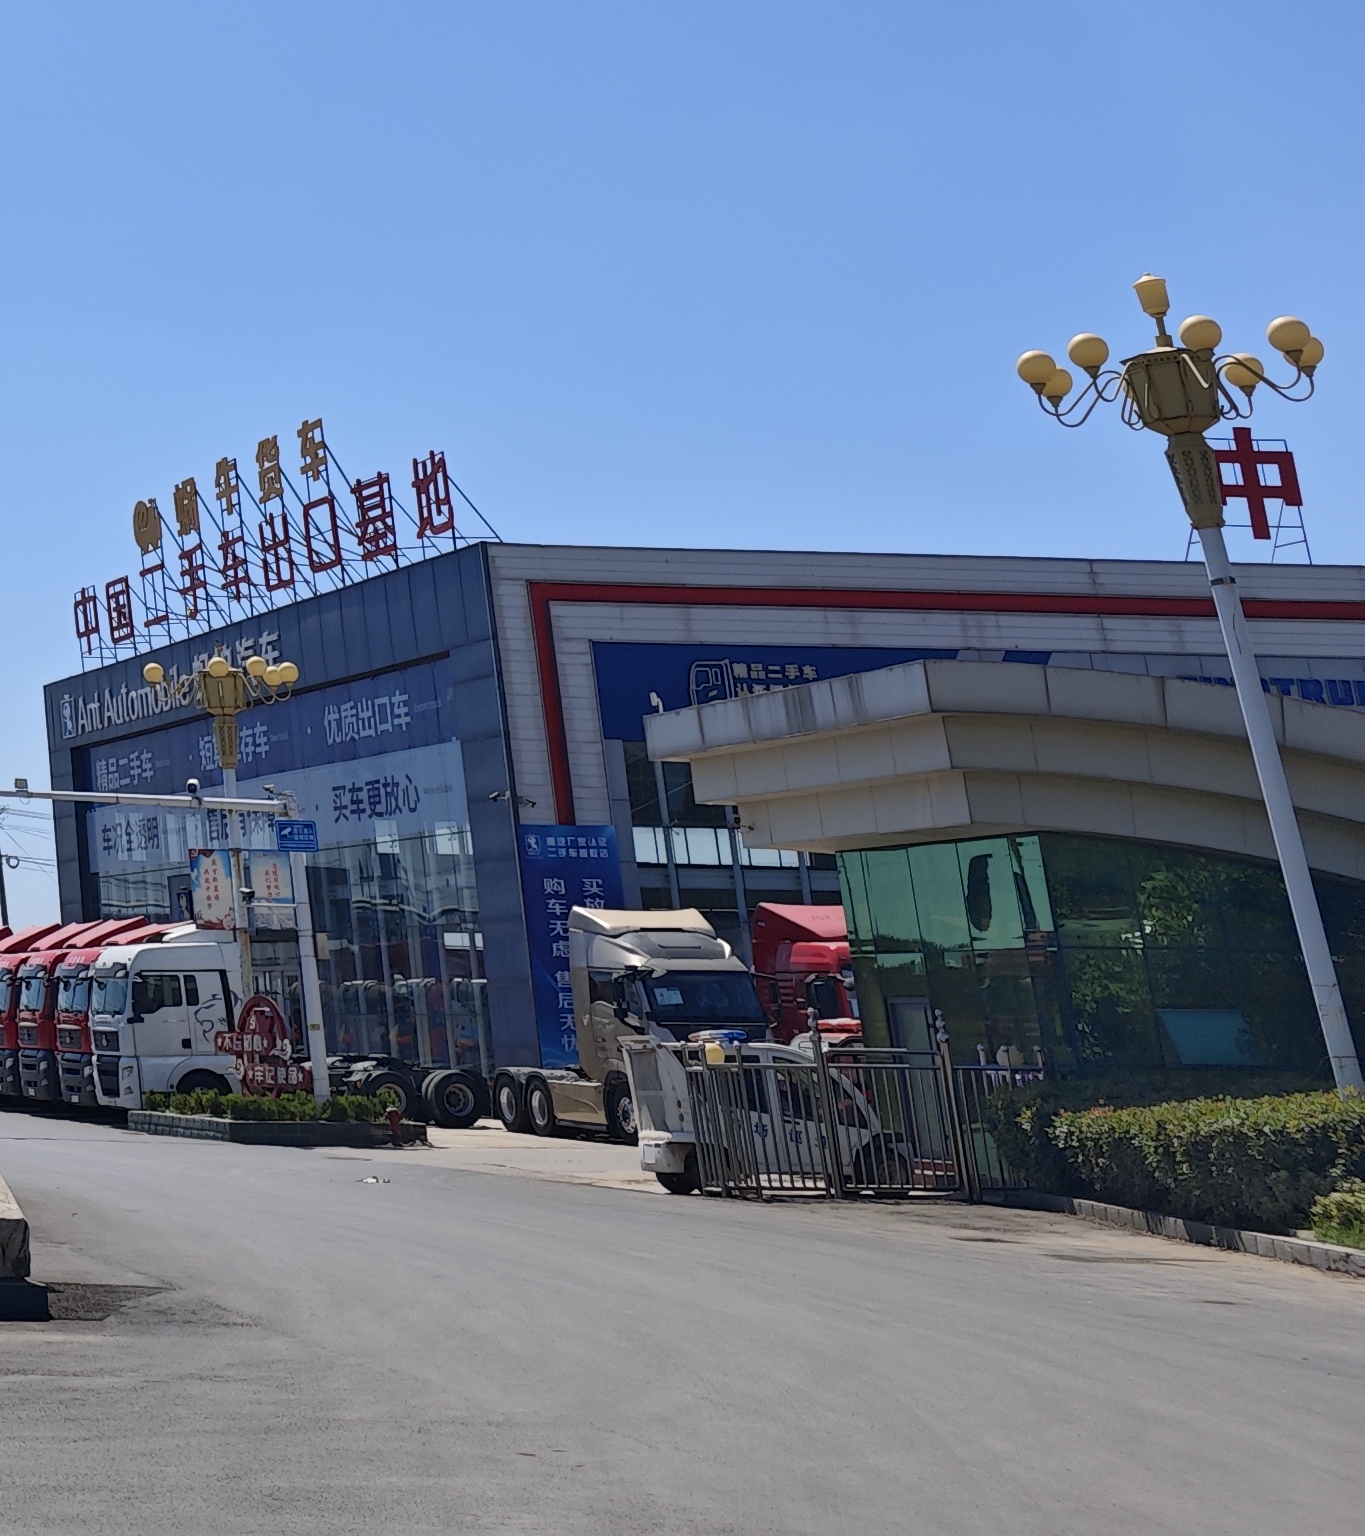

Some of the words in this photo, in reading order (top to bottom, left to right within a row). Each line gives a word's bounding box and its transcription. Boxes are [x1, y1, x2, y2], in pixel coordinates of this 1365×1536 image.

[173, 417, 328, 537] 蜗牛货车
[73, 449, 455, 655] 中国二手车出口基地
[732, 662, 818, 681] 精品二手车
[76, 691, 103, 736] Ant
[103, 662, 191, 729] Automobile
[323, 689, 412, 746] 优质出口车
[95, 748, 155, 792] 精品二手车
[198, 720, 270, 772] 短存车
[331, 773, 421, 824] 买车更放心
[101, 816, 160, 857] 车况全透明
[542, 877, 570, 959] 购车无虑
